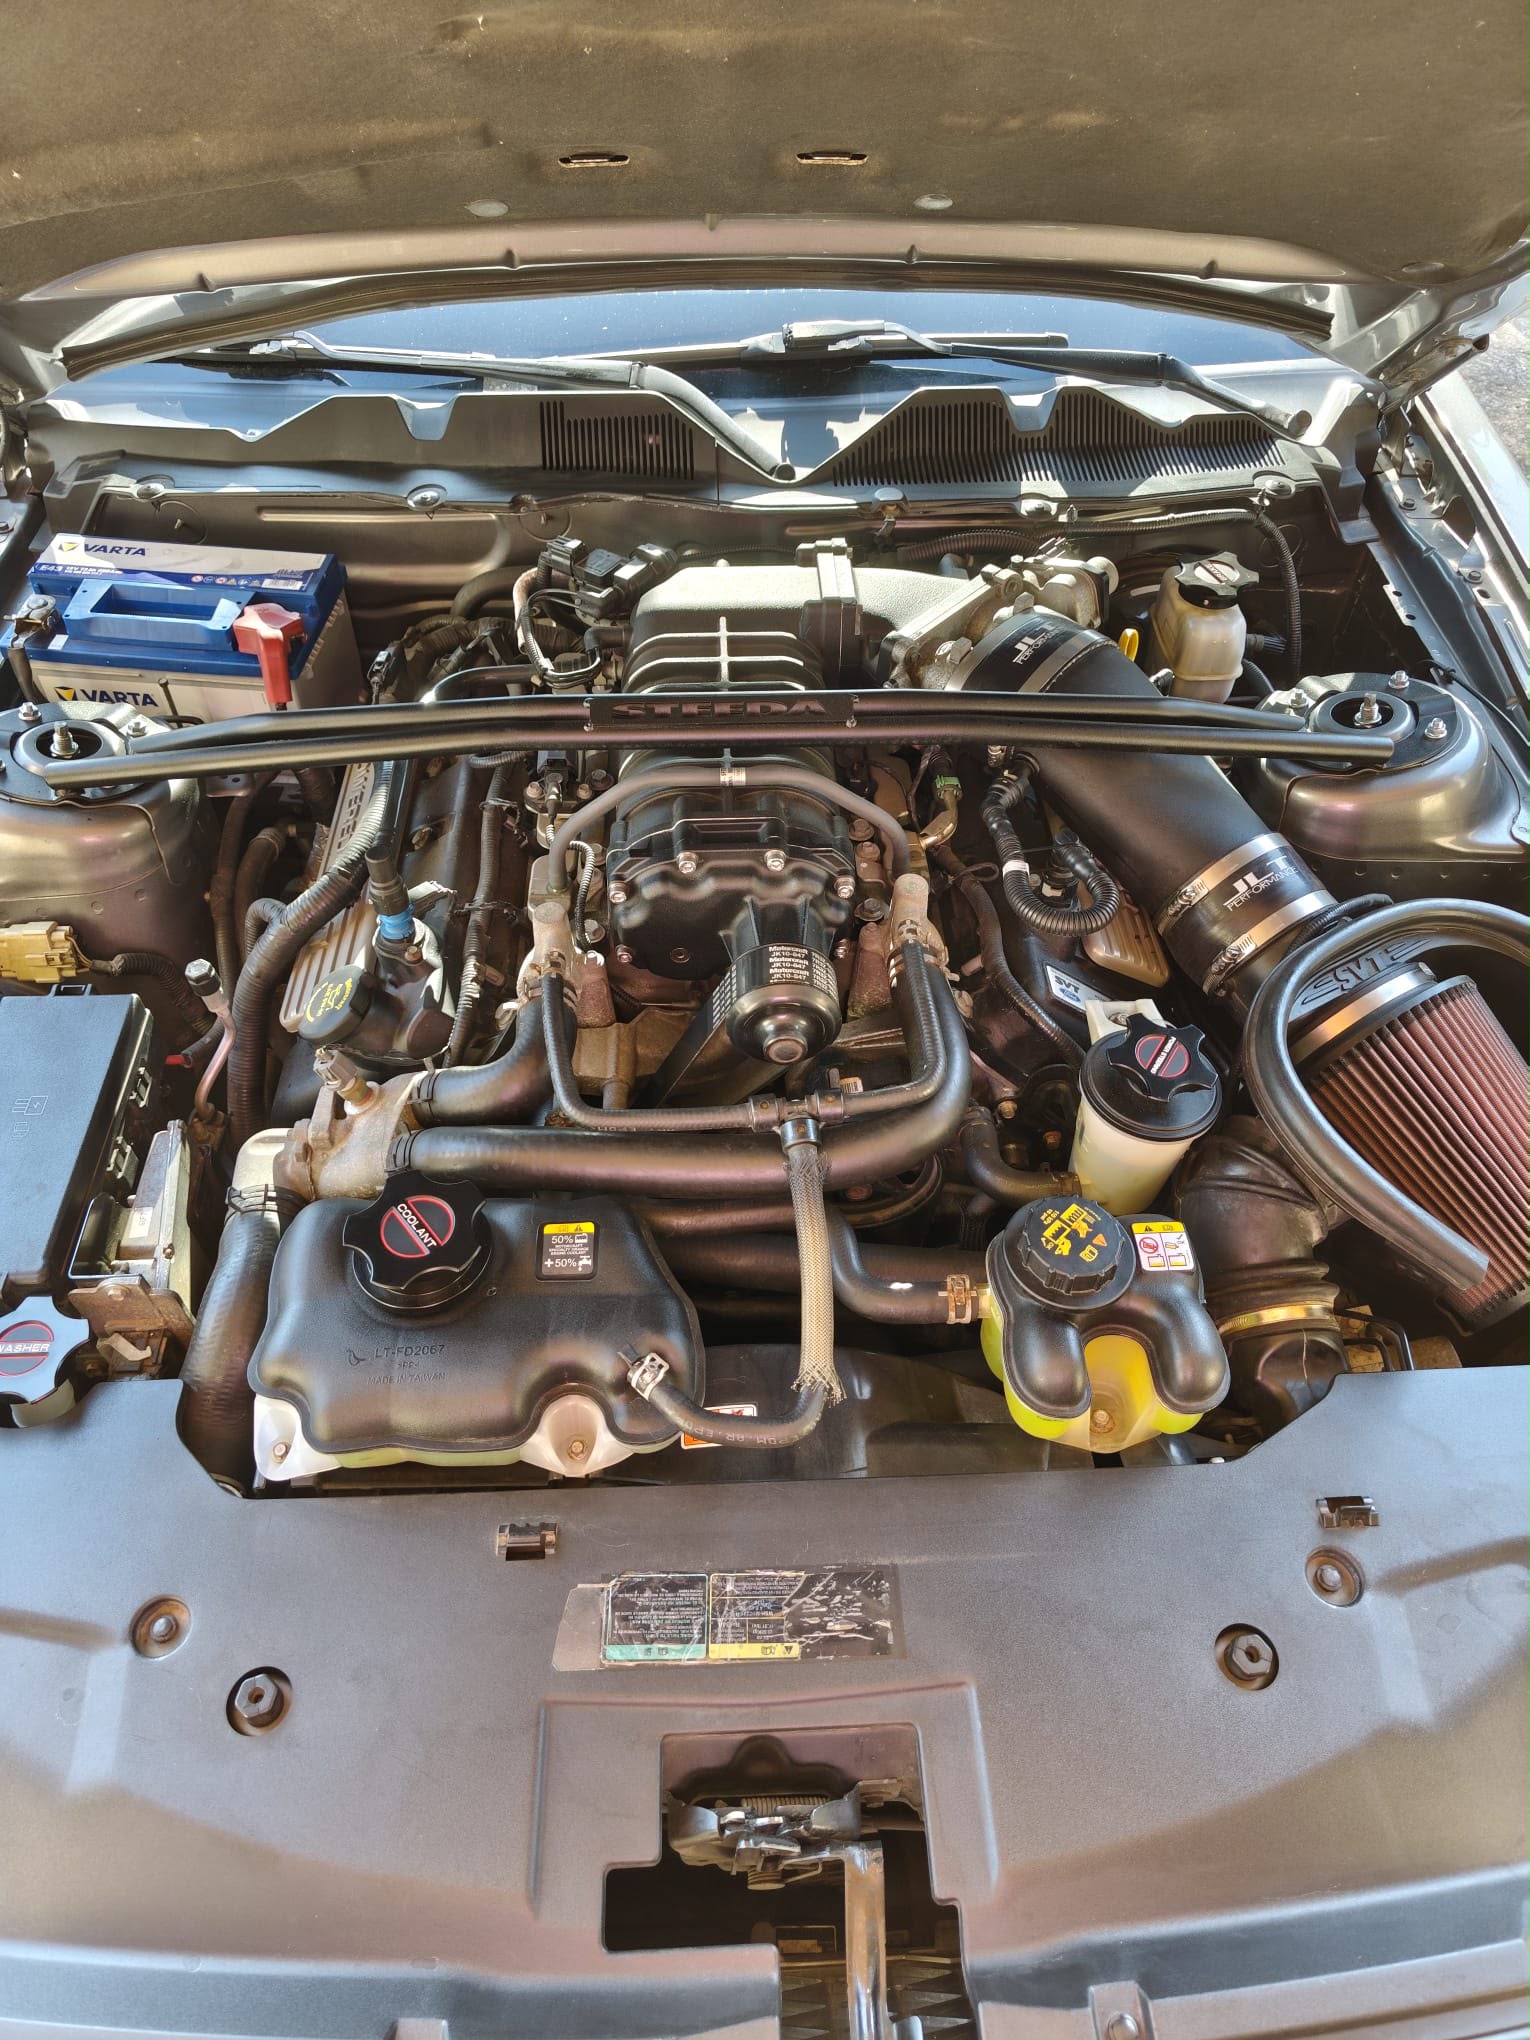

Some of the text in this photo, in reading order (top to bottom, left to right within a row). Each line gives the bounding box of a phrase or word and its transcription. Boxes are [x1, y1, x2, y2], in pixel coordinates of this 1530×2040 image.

[84, 543, 146, 556] VARTA
[80, 689, 159, 707] VARTA
[612, 700, 827, 718] STEEDA
[1226, 866, 1299, 911] PERFORMANCE
[1334, 949, 1388, 991] SVT
[1054, 975, 1080, 994] SVT
[397, 1203, 437, 1248] COOLANT
[551, 1235, 574, 1244] 50%
[374, 1344, 445, 1358] LT-FD2067
